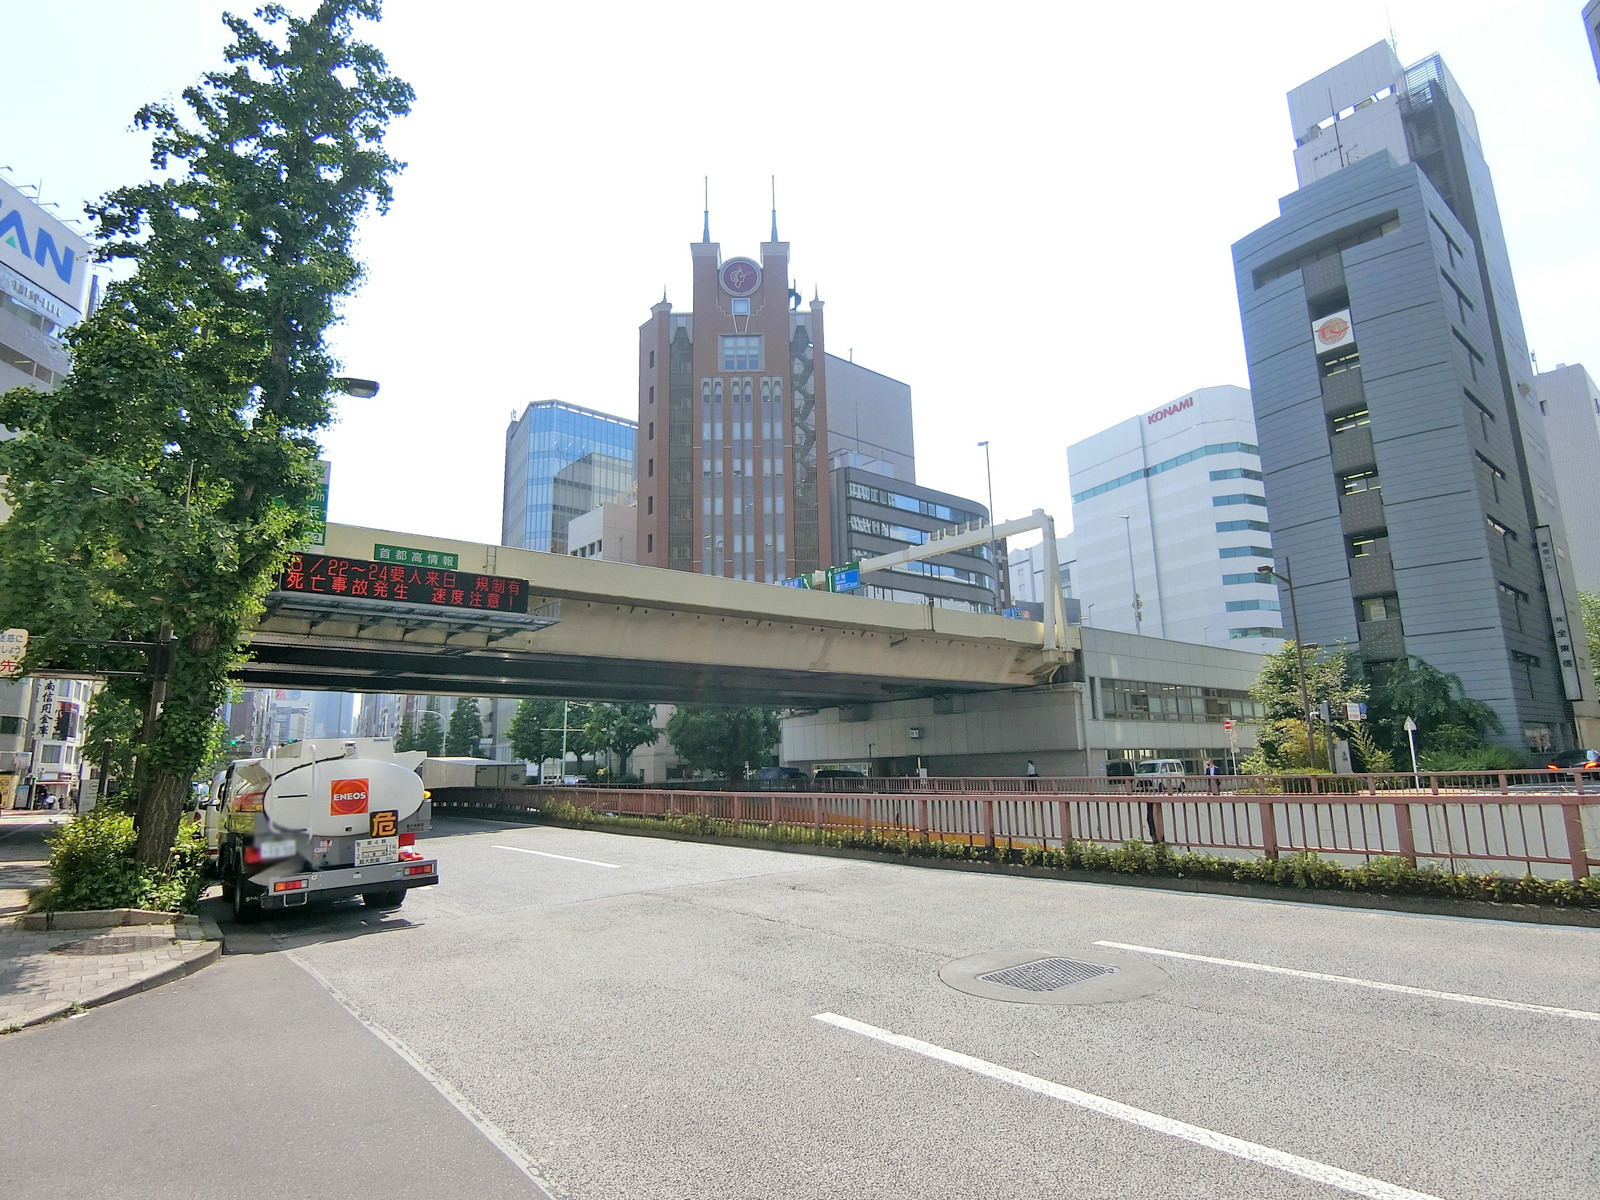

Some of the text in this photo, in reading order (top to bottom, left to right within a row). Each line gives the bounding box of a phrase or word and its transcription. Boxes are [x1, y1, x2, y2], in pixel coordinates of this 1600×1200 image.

[0, 199, 75, 285] AN
[1148, 397, 1193, 424] KONAMI
[379, 547, 454, 567] 首都高情報
[286, 571, 409, 600] 死亡事故発生
[475, 575, 520, 596] 規制有
[0, 645, 22, 654] しょう
[333, 791, 367, 802] ENEOS
[371, 811, 397, 837] 危
